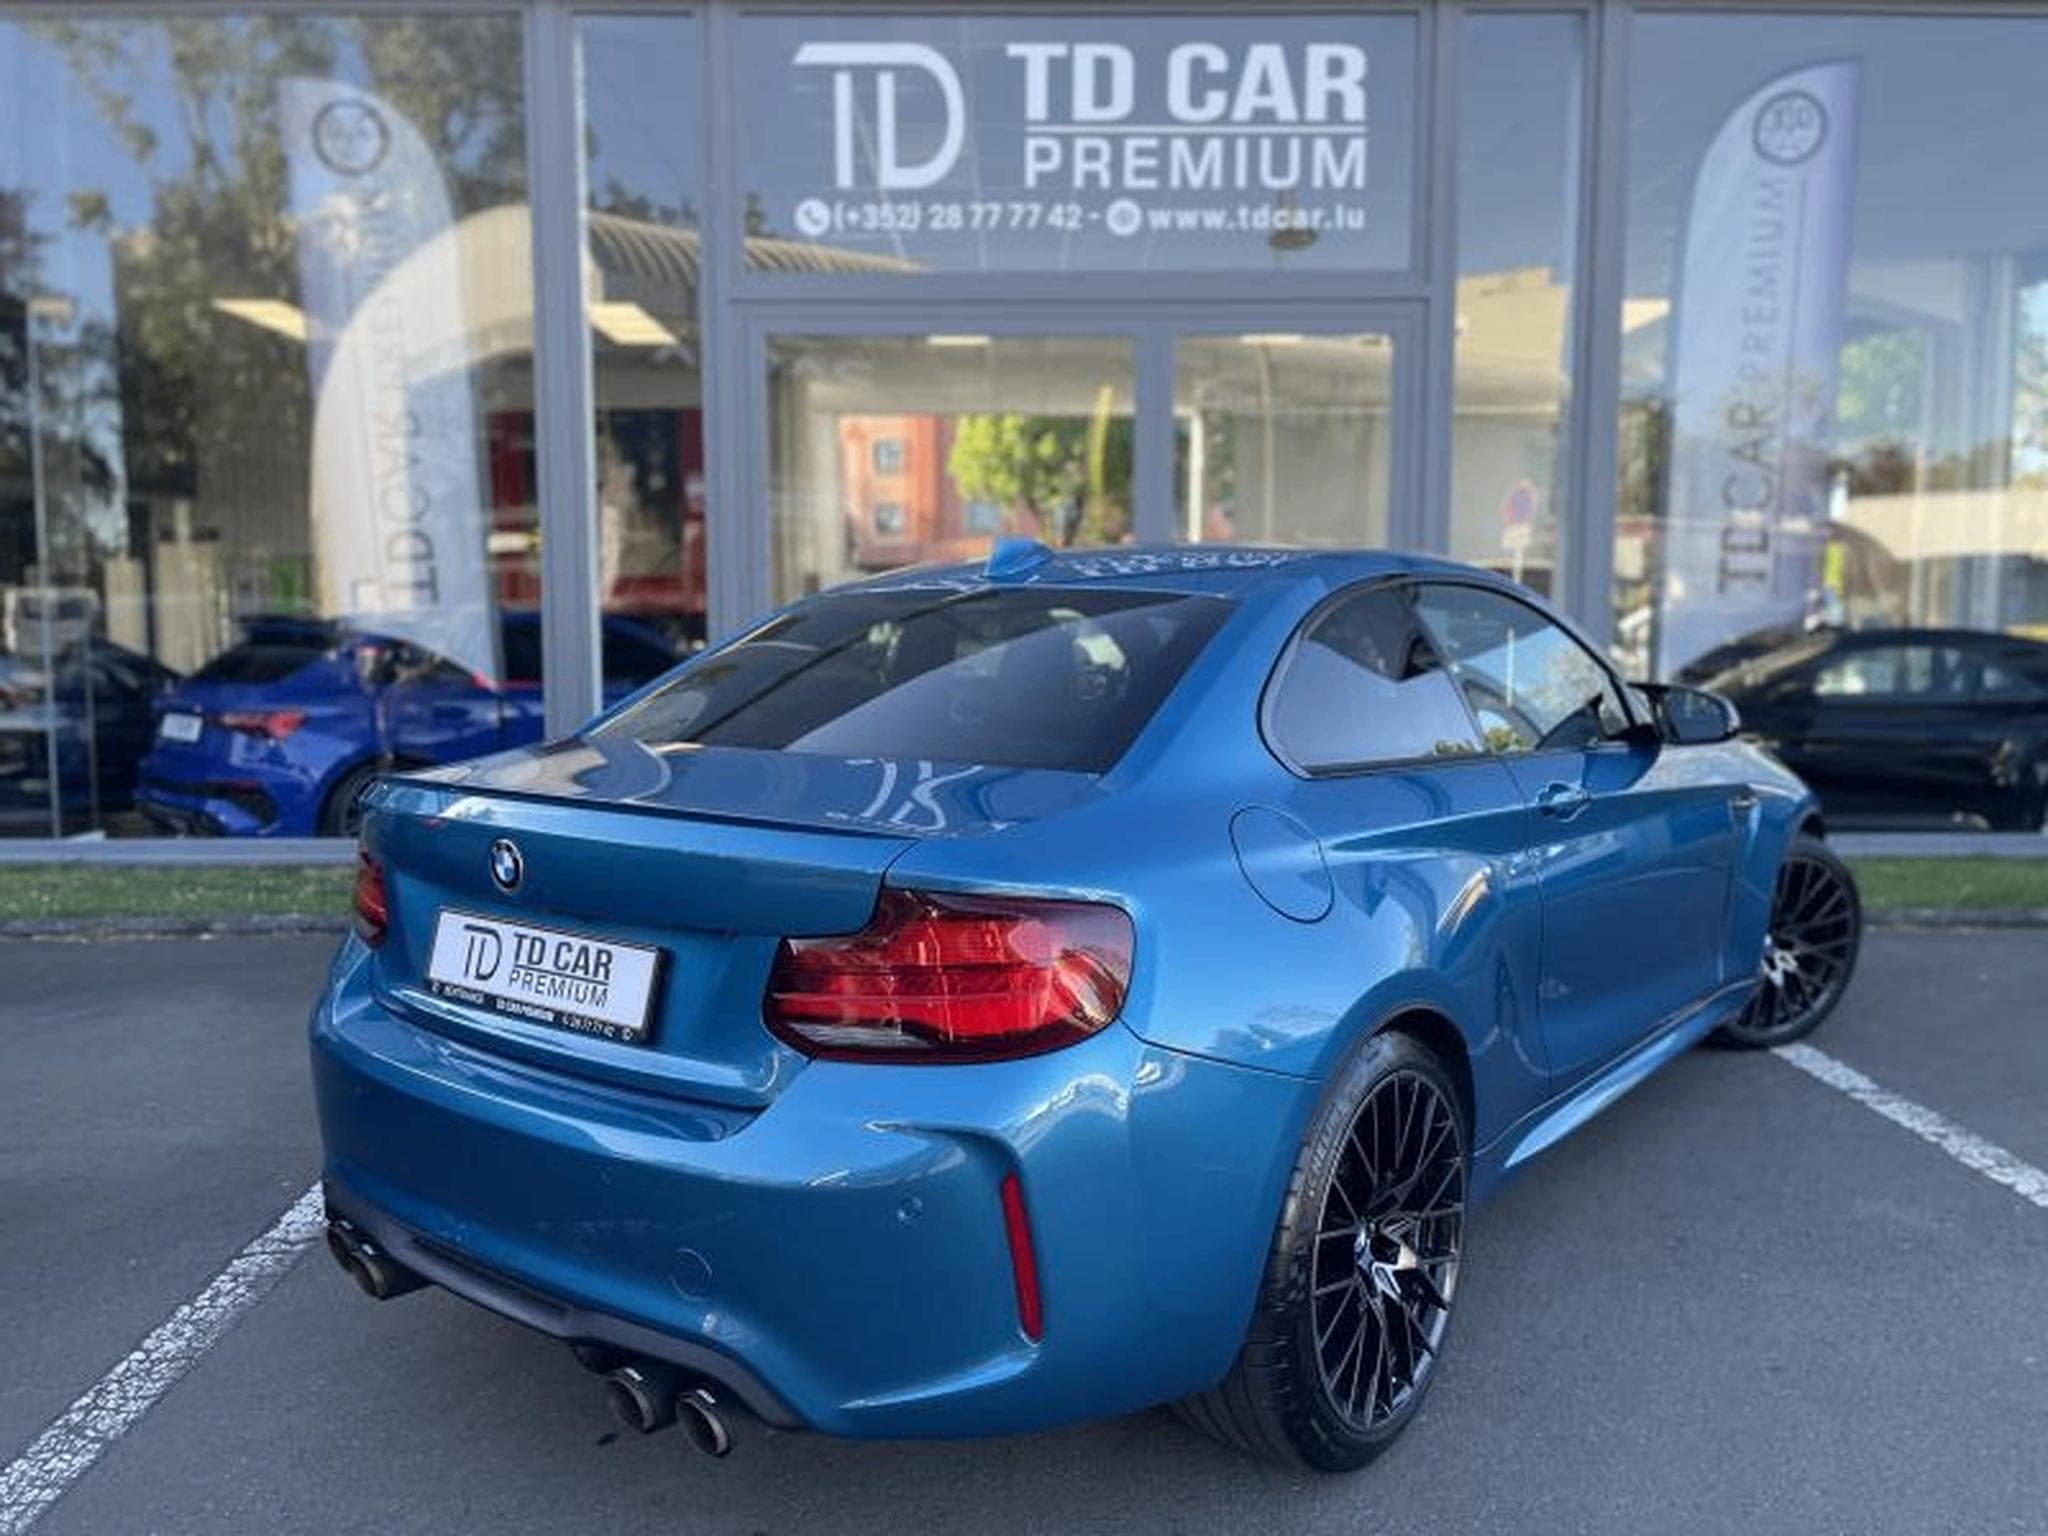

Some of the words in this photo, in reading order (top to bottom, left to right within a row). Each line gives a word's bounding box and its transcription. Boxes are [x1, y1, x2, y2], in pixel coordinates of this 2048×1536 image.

[1006, 42, 1135, 123] TD
[1166, 42, 1369, 123] CAR
[1024, 136, 1368, 190] PREMIUM
[833, 201, 922, 231] (+352)
[969, 203, 1003, 230] 77
[1007, 203, 1042, 230] 77
[1047, 203, 1083, 230] 42
[1147, 203, 1366, 230] www.tdcar.lu
[513, 933, 546, 966] TD
[553, 940, 614, 981] CAR
[508, 969, 610, 1008] PREMIUM
